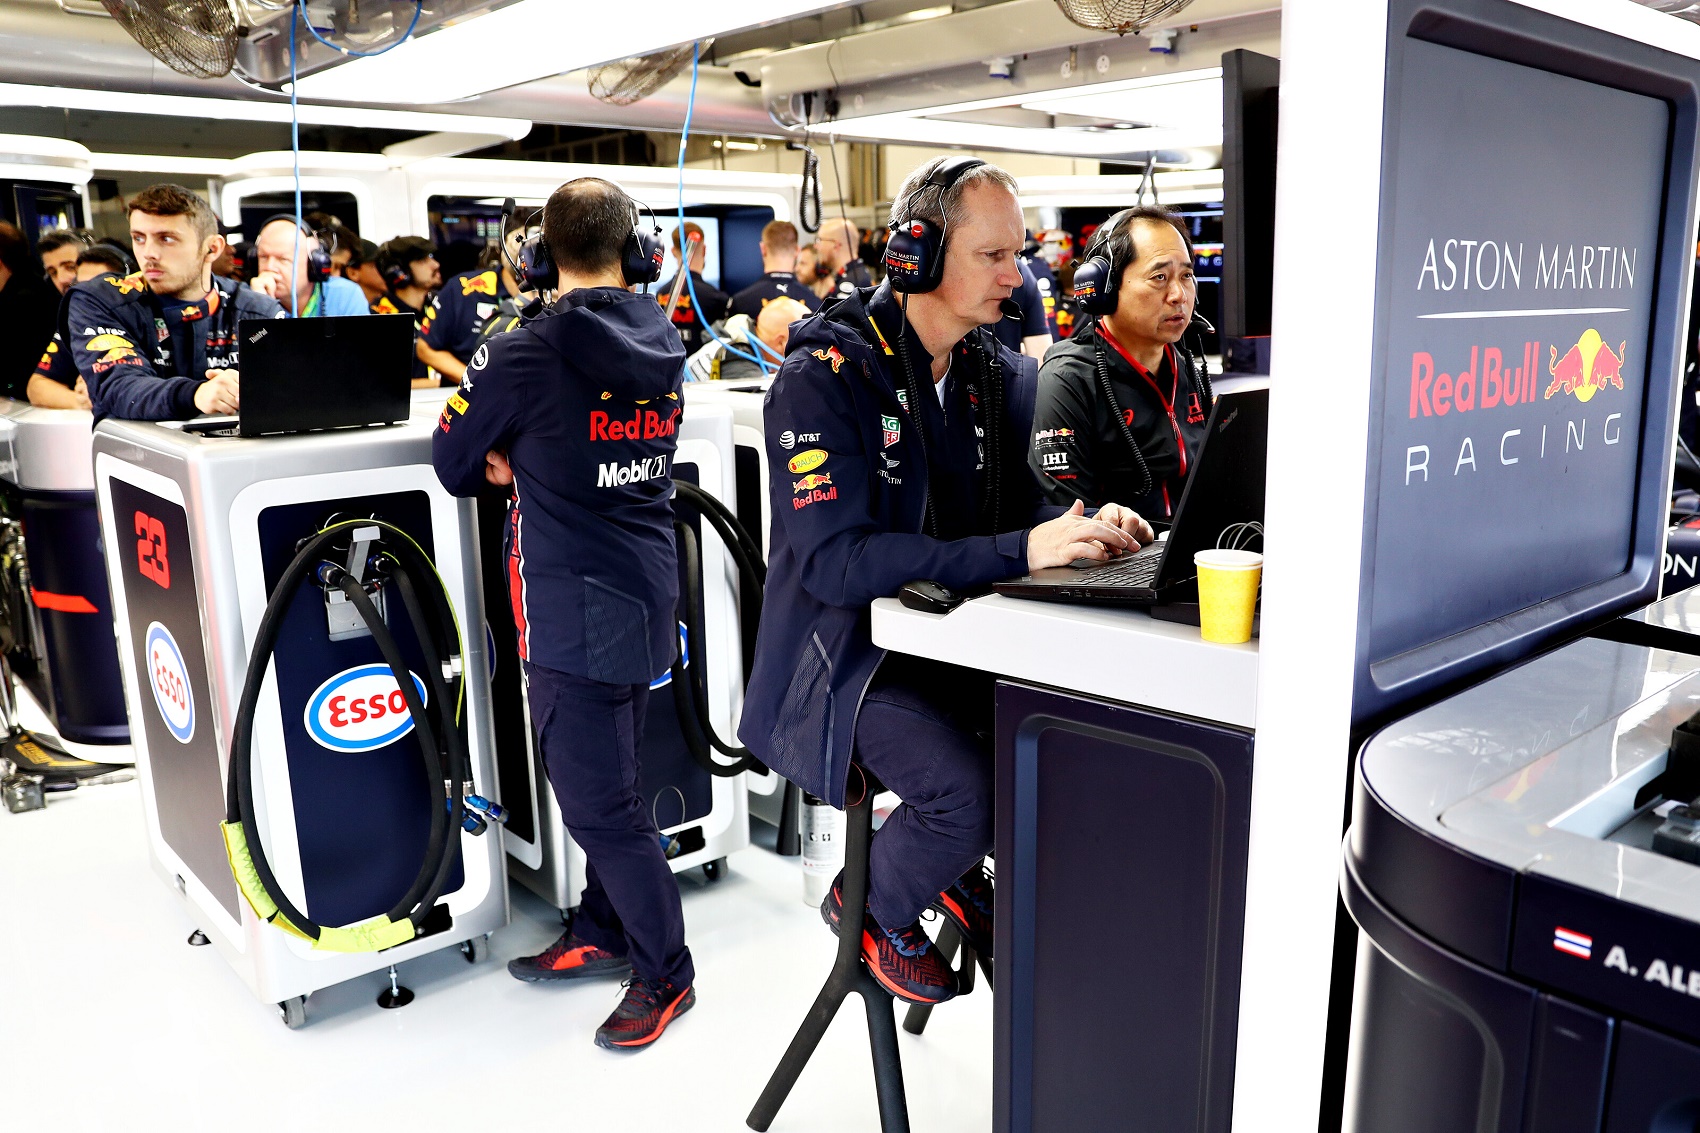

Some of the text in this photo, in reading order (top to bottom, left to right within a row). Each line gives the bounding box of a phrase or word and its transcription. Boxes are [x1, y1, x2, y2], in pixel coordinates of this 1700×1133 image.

[898, 252, 920, 261] MARTIN
[1416, 237, 1637, 292] ASTON MARTIN
[1409, 341, 1540, 419] Red Bull
[589, 408, 681, 441] Red Bull
[797, 433, 822, 443] AT&T
[881, 418, 897, 431] AG
[795, 453, 823, 469] RAUCH
[1043, 452, 1068, 466] IHI
[1405, 412, 1622, 486] RACING
[596, 458, 653, 488] Mobil
[792, 486, 838, 511] Red Bull
[134, 511, 170, 589] 23
[1603, 944, 1639, 978] A.
